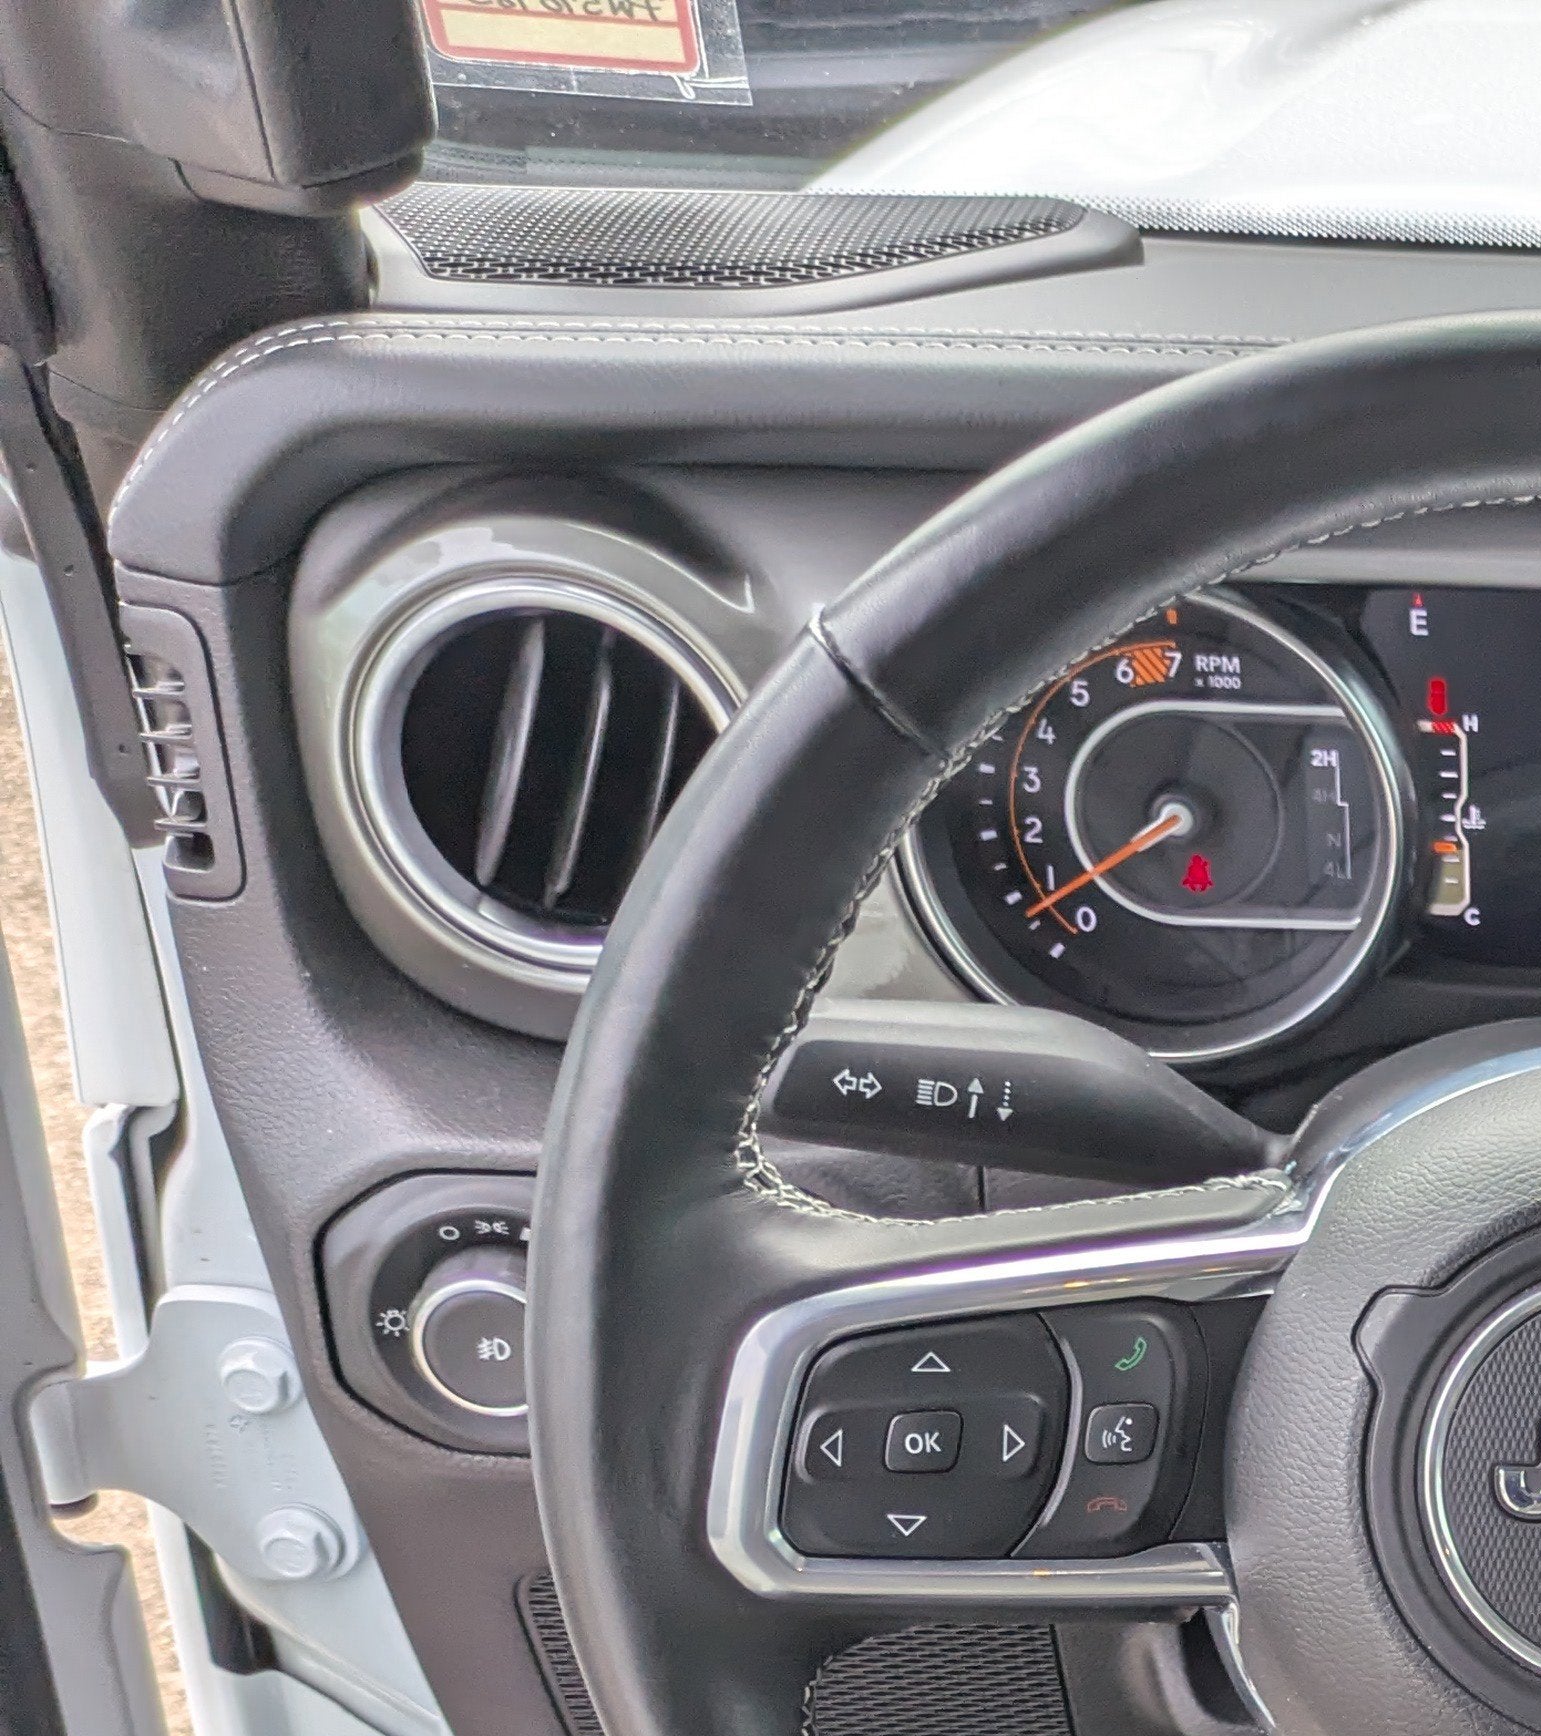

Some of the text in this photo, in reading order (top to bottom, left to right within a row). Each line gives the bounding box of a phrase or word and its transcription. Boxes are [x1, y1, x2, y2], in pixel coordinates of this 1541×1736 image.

[1409, 608, 1429, 637] E
[1116, 658, 1135, 684] 6
[1163, 650, 1183, 679] 7
[1194, 654, 1241, 675] RPM
[1069, 678, 1091, 708] 5
[1208, 675, 1242, 690] 1000
[1036, 717, 1057, 745] 4
[1462, 714, 1480, 734] H
[1309, 749, 1338, 768] 2H
[1022, 765, 1042, 794] 3
[1023, 815, 1044, 845] 2
[1045, 863, 1056, 892] 1
[1075, 904, 1098, 933] 0
[1463, 908, 1481, 927] C
[903, 1430, 943, 1457] OK
